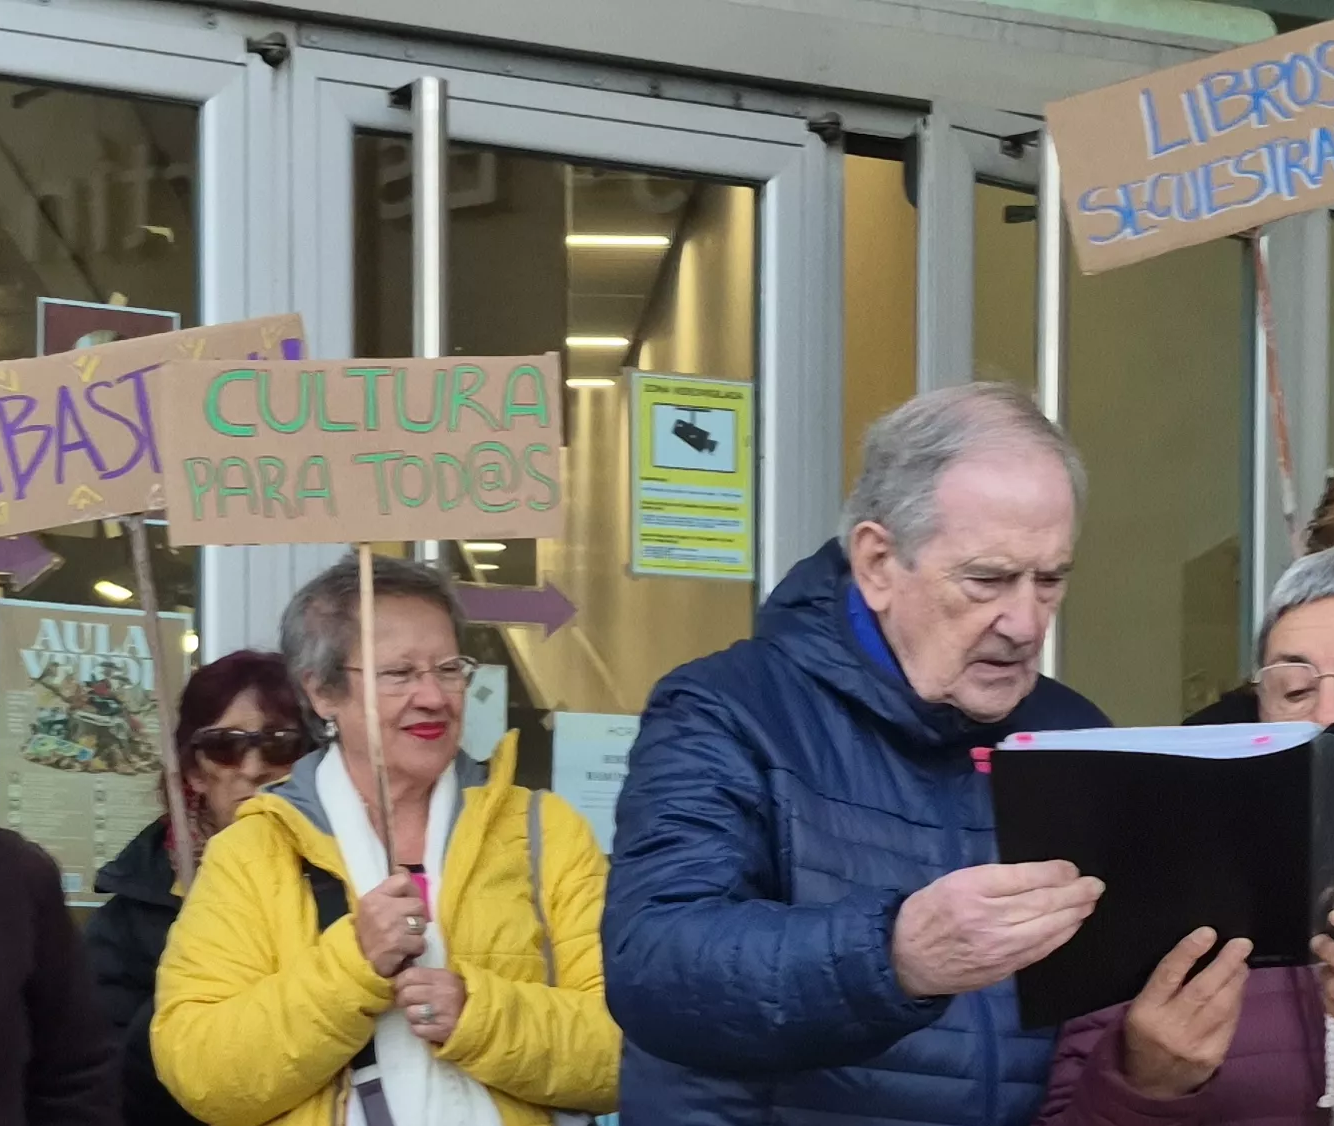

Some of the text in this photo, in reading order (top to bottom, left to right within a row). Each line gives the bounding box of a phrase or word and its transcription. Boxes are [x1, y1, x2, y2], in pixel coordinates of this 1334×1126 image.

[204, 365, 550, 438] CULTURA
[183, 441, 561, 521] PARA TOD@S
[31, 618, 154, 658] AULA
